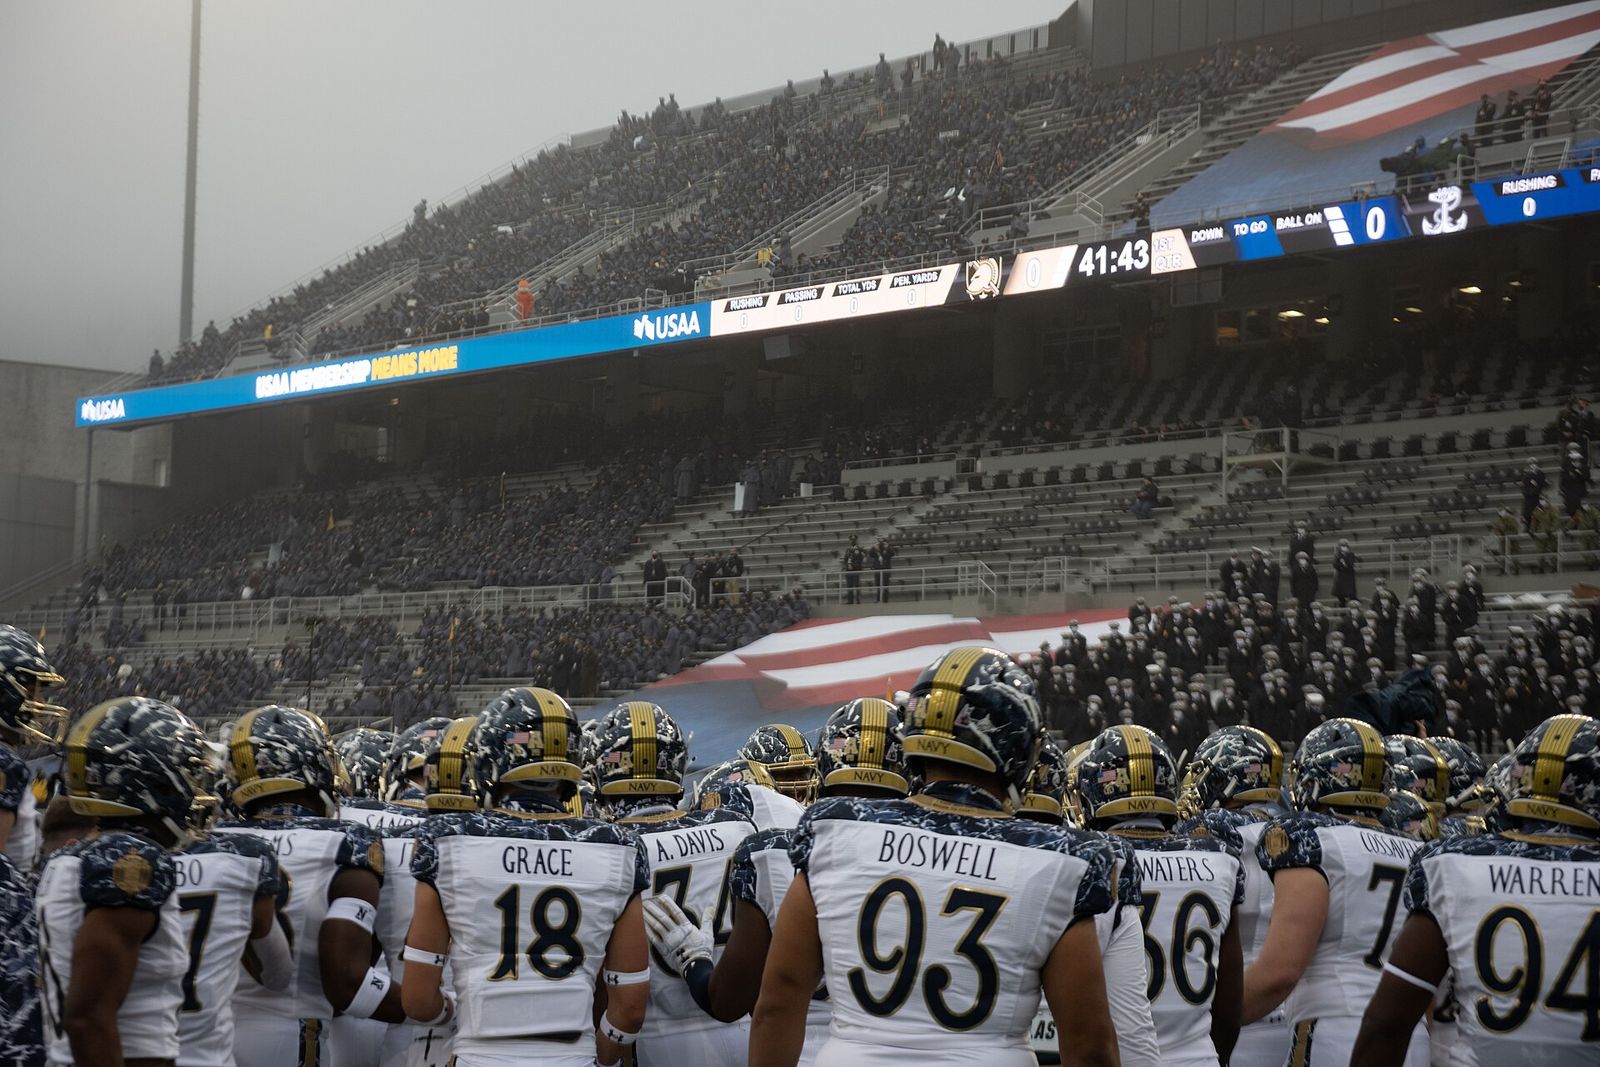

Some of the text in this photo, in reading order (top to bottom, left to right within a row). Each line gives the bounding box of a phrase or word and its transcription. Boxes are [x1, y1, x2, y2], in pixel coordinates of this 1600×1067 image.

[1502, 175, 1557, 195] RUSHING
[1523, 197, 1536, 217] 0
[1233, 220, 1268, 236] TO GO
[1276, 211, 1323, 230] BALL ON
[1366, 206, 1386, 240] 0
[1191, 226, 1224, 243] DOWN
[1153, 237, 1175, 251] 1ST
[1078, 239, 1149, 277] 41:43
[1155, 254, 1184, 270] QTR
[893, 271, 938, 287] PEN. YARDS
[1026, 257, 1041, 288] 0
[784, 288, 817, 303] PASSING
[837, 280, 877, 295] TOTAL YDS
[730, 296, 763, 311] RUSHING
[850, 296, 859, 313] 0
[907, 288, 917, 305] 0
[740, 312, 749, 329] 0
[794, 304, 803, 321] 0
[655, 311, 700, 339] USAA
[256, 345, 458, 399] USAA MEMBERSHIP MEANS MORE
[917, 738, 951, 755] NAVY
[540, 765, 568, 777] NAVY
[854, 770, 885, 783] NAVY
[628, 782, 656, 793] NAVY
[438, 797, 464, 808] NAVY
[1127, 801, 1157, 812] NAVY
[1354, 794, 1379, 805] NAVY
[1527, 804, 1559, 818] NAVY
[656, 828, 725, 863] A. DAVIS
[502, 845, 574, 877] GRACE
[878, 830, 997, 881] BOSWELL
[1141, 856, 1216, 882] WATERS
[1488, 864, 1600, 897] WARREN
[1362, 862, 1408, 969] 7
[486, 882, 587, 982] 18
[847, 875, 1011, 1032] 93
[1474, 903, 1600, 1042] 94
